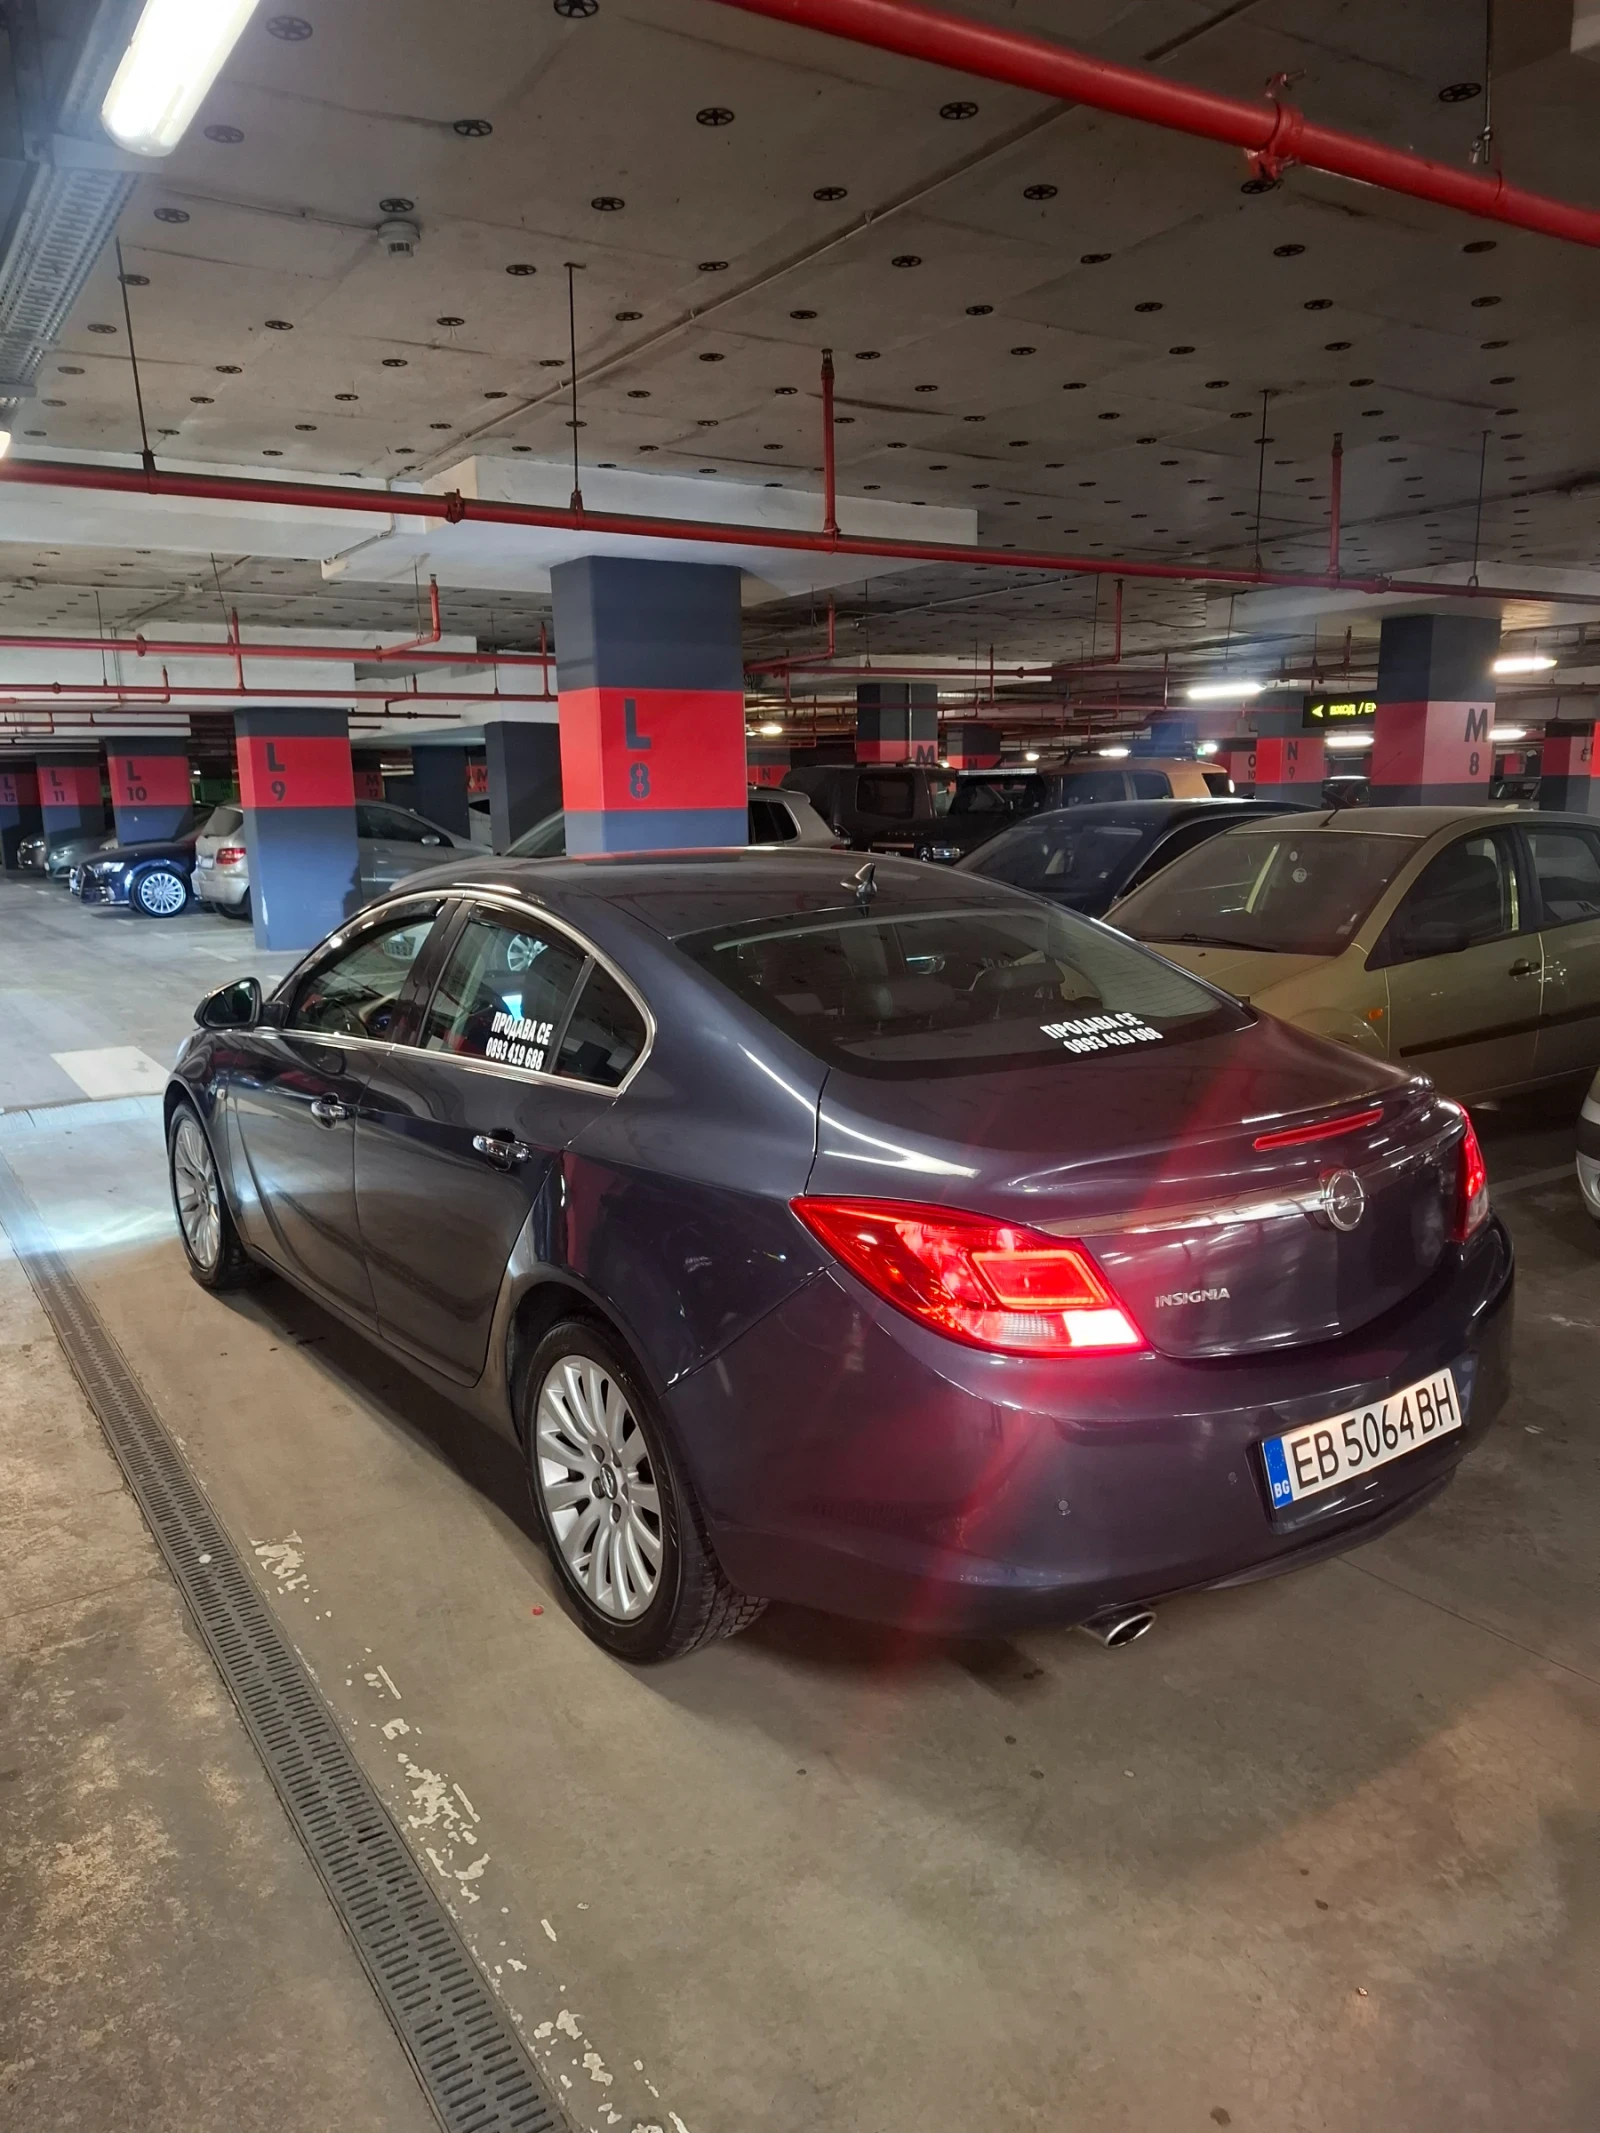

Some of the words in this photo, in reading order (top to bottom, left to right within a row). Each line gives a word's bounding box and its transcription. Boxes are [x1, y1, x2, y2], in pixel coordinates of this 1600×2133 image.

[1330, 704, 1356, 715] ВХОД
[624, 698, 652, 749] L
[1464, 708, 1488, 742] M
[266, 742, 286, 772] L
[916, 745, 935, 763] M
[1287, 741, 1298, 761] N
[127, 760, 141, 781] L
[762, 768, 771, 780] N
[1288, 766, 1295, 779] 9
[1469, 752, 1479, 776] 8
[4, 776, 13, 789] L
[50, 770, 62, 786] L
[629, 762, 651, 799] 8
[4, 792, 16, 802] 12
[54, 790, 65, 802] 11
[127, 786, 147, 801] 10
[271, 780, 286, 801] 9
[491, 1011, 537, 1042] ПРОДАВА
[536, 1022, 553, 1045] СЕ
[1040, 1015, 1124, 1039] ПРОДАВА
[1115, 1012, 1145, 1026] СЕ
[1063, 1035, 1108, 1053] 0893
[1102, 1030, 1135, 1045] 419
[485, 1037, 508, 1060] 0893
[507, 1043, 525, 1065] 419
[524, 1047, 544, 1070] 688
[1155, 1288, 1230, 1308] INSIGNIA
[1290, 1429, 1339, 1489] EB
[1341, 1396, 1415, 1467] 5064
[1416, 1377, 1455, 1435] BH
[1274, 1479, 1290, 1498] BG
